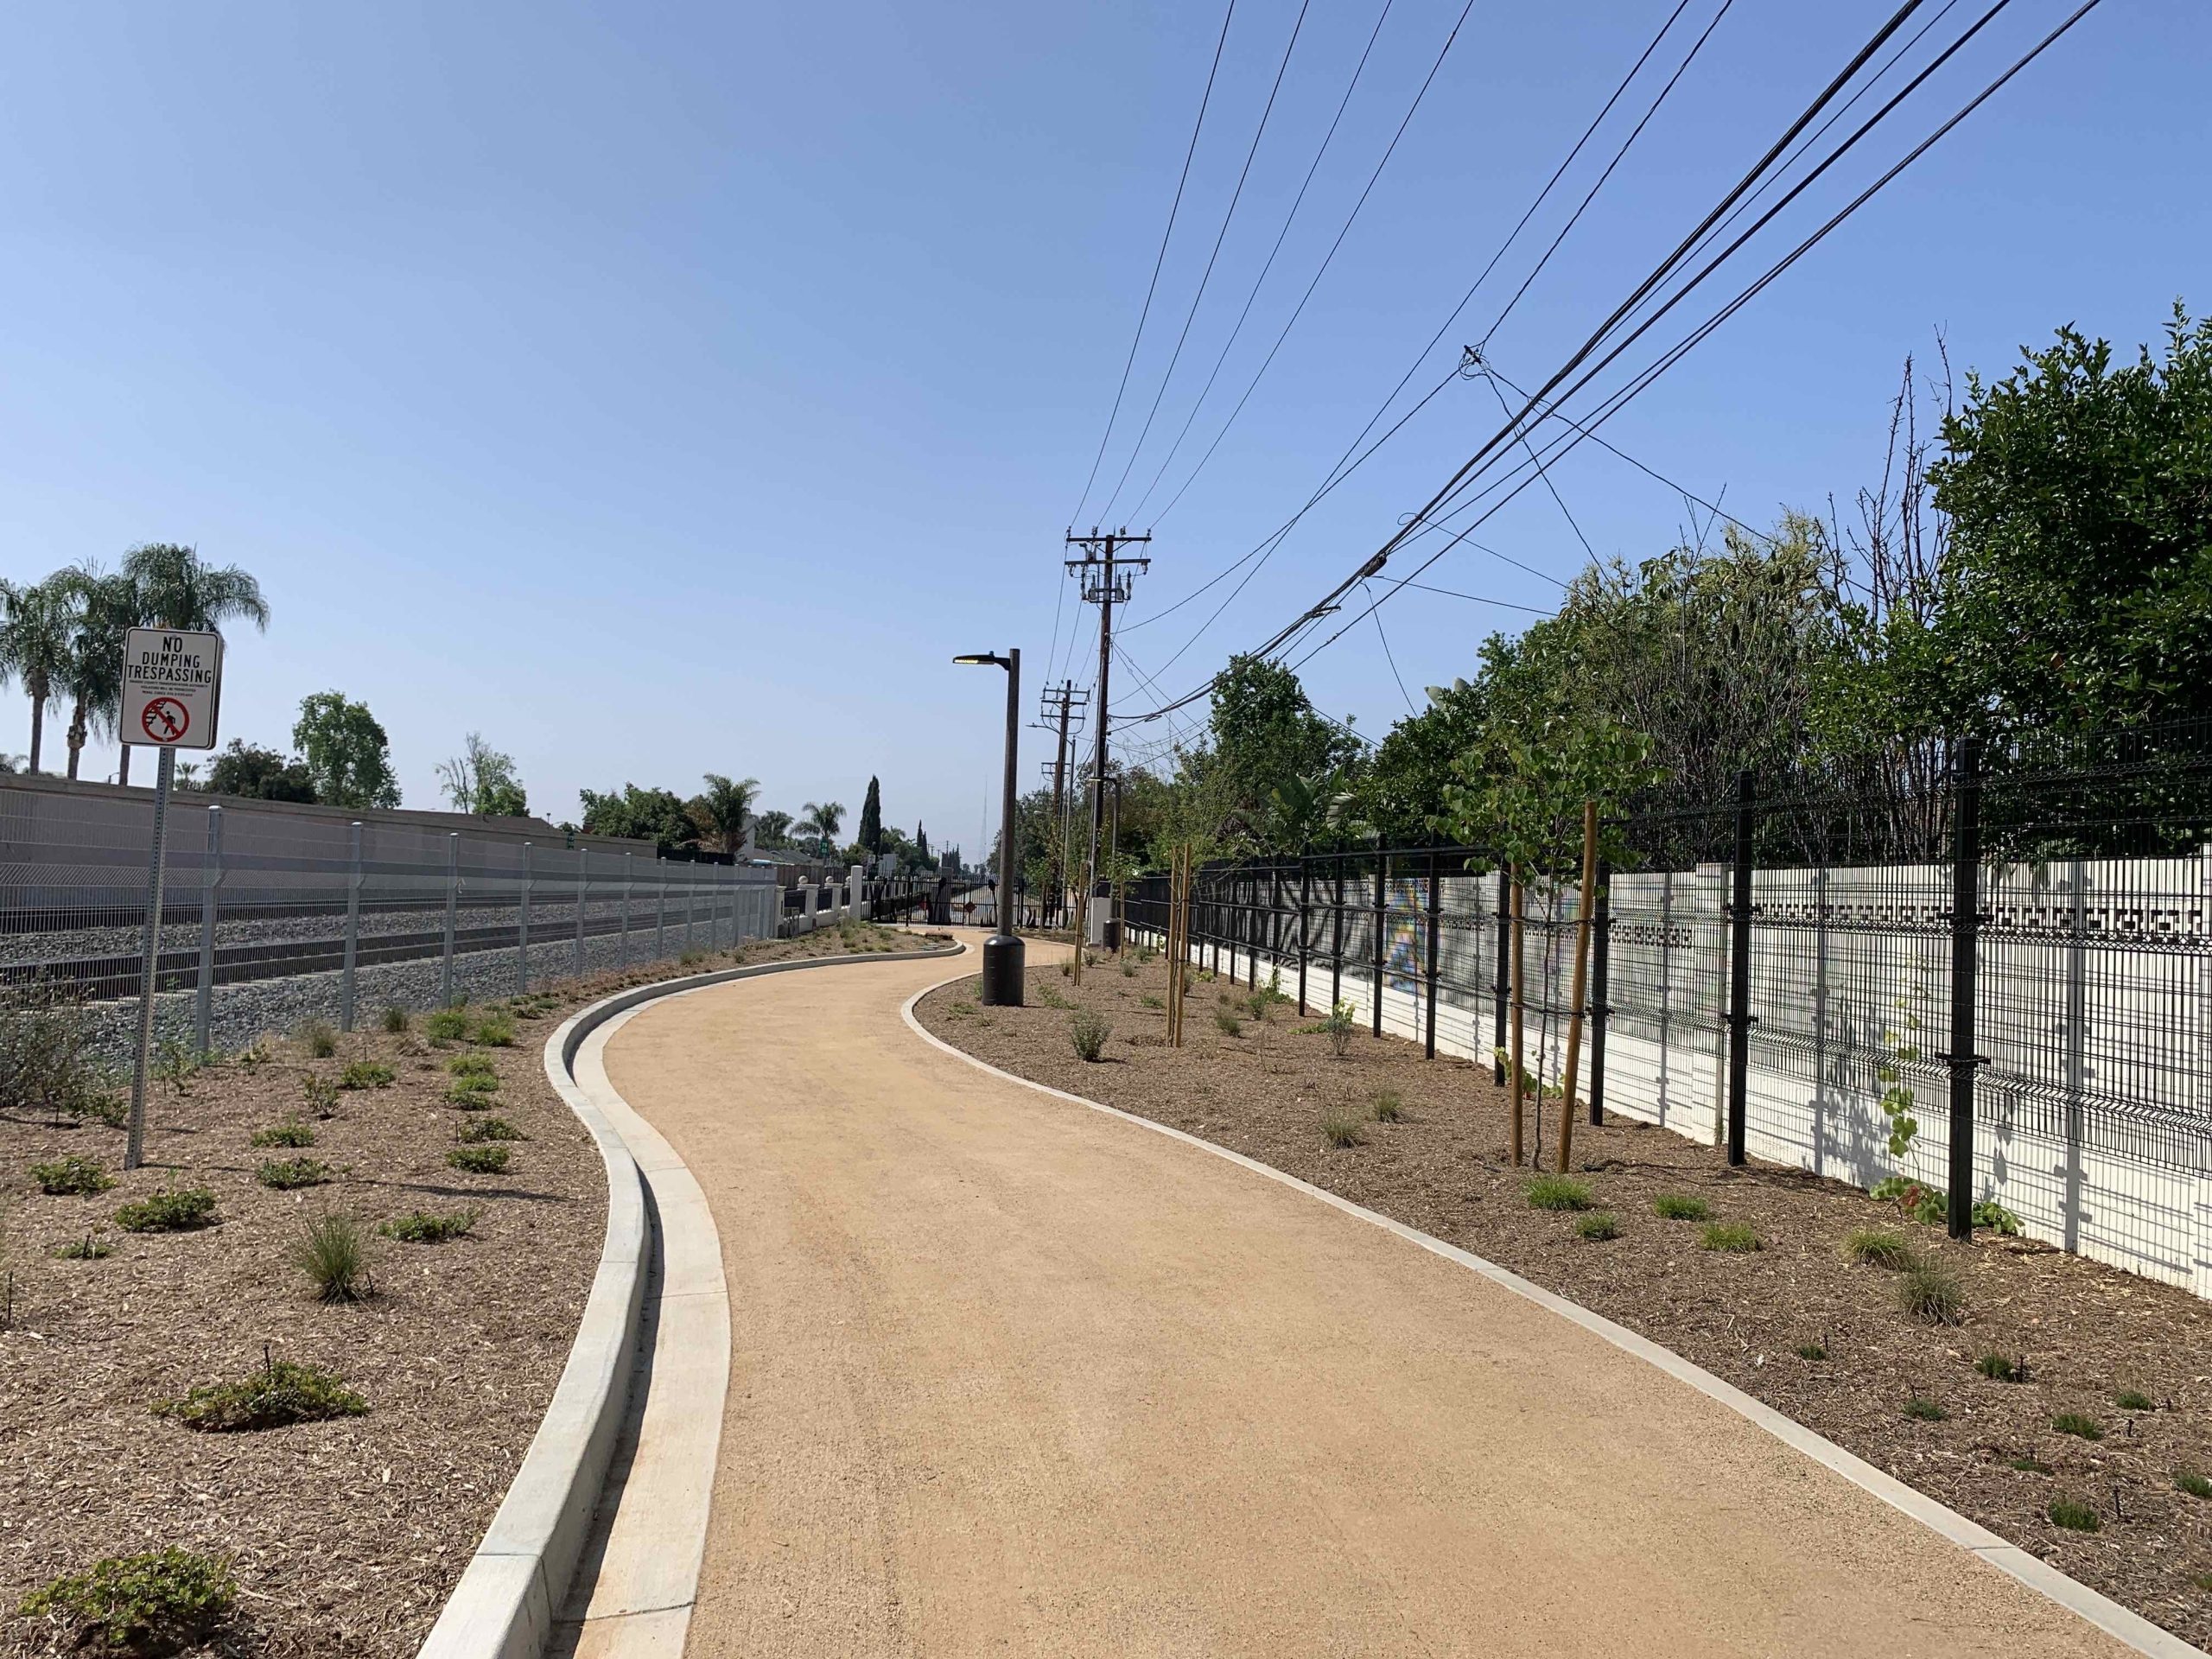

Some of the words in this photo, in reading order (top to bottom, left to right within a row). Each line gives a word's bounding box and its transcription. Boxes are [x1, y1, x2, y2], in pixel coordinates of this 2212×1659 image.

[162, 637, 183, 652] NO
[142, 652, 200, 668] DUMPING
[128, 664, 212, 683] TRESPASSING
